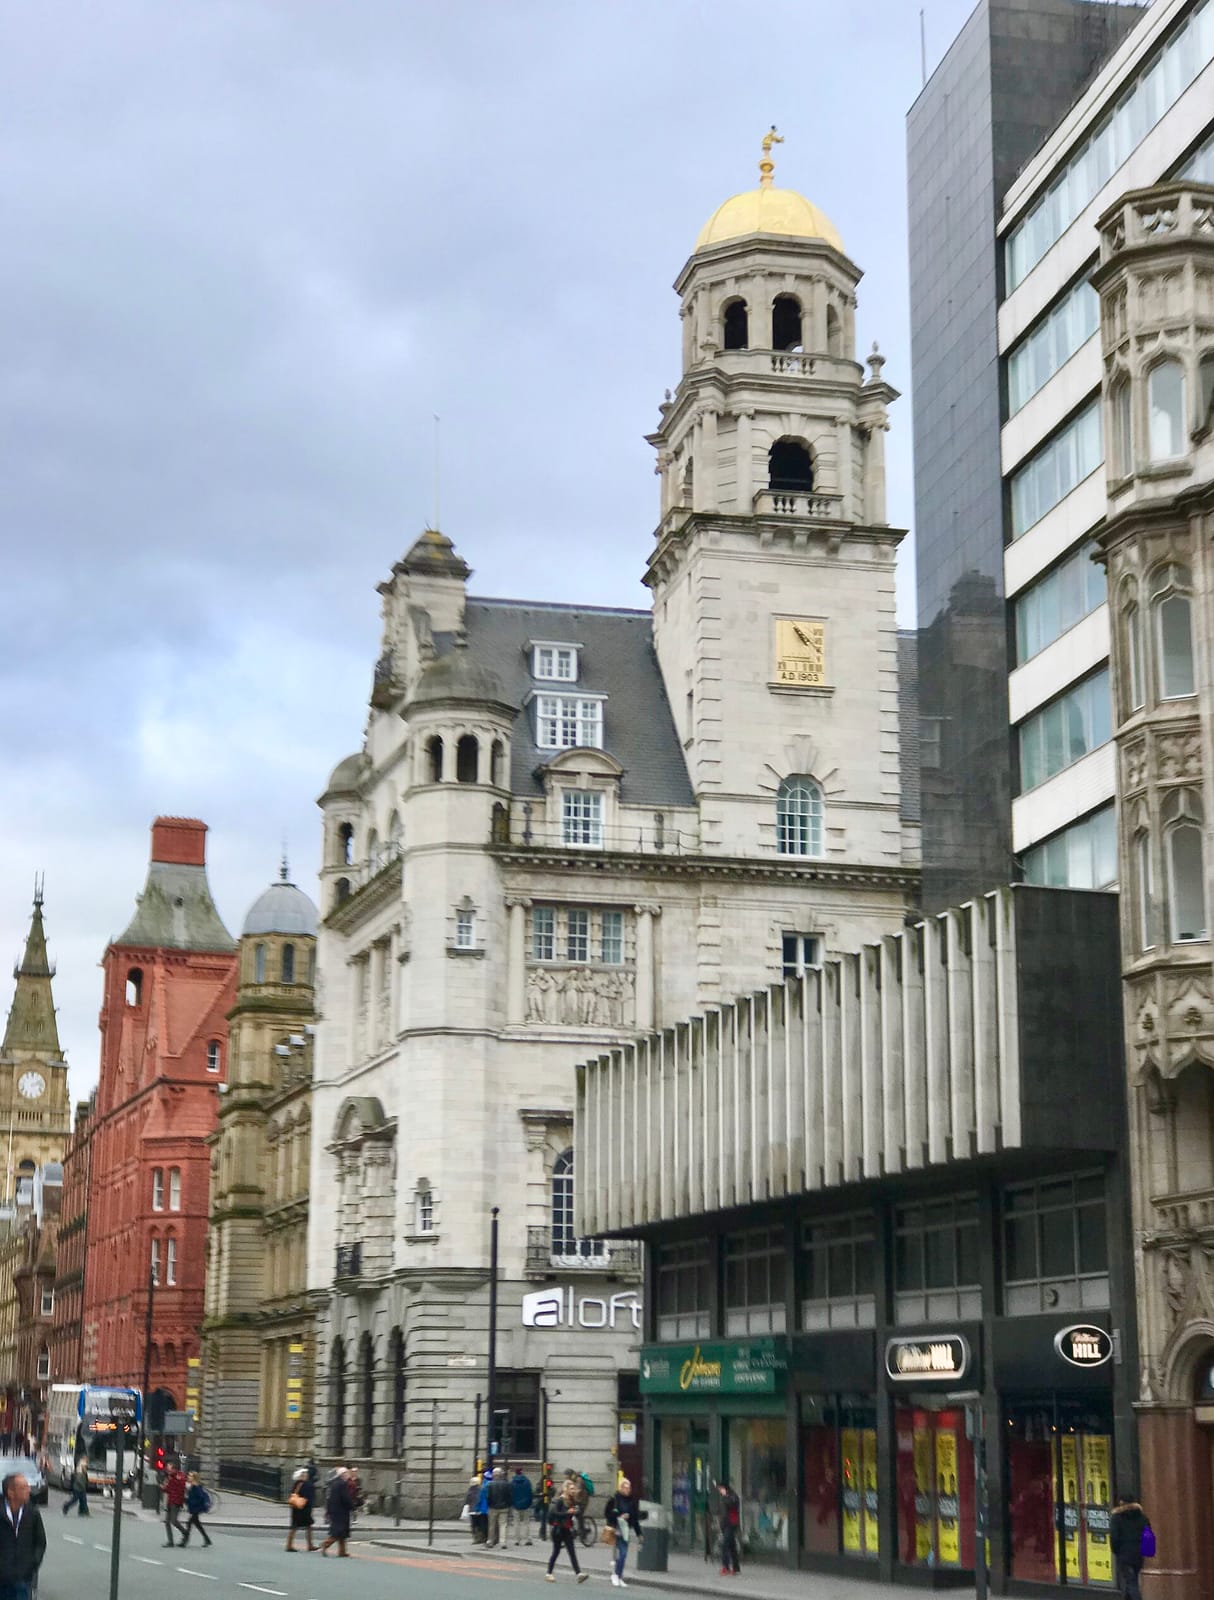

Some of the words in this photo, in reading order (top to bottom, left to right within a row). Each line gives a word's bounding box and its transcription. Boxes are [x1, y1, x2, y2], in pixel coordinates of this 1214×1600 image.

[798, 673, 819, 681] 1903
[522, 1285, 642, 1328] aloft
[1073, 1343, 1101, 1358] HILL
